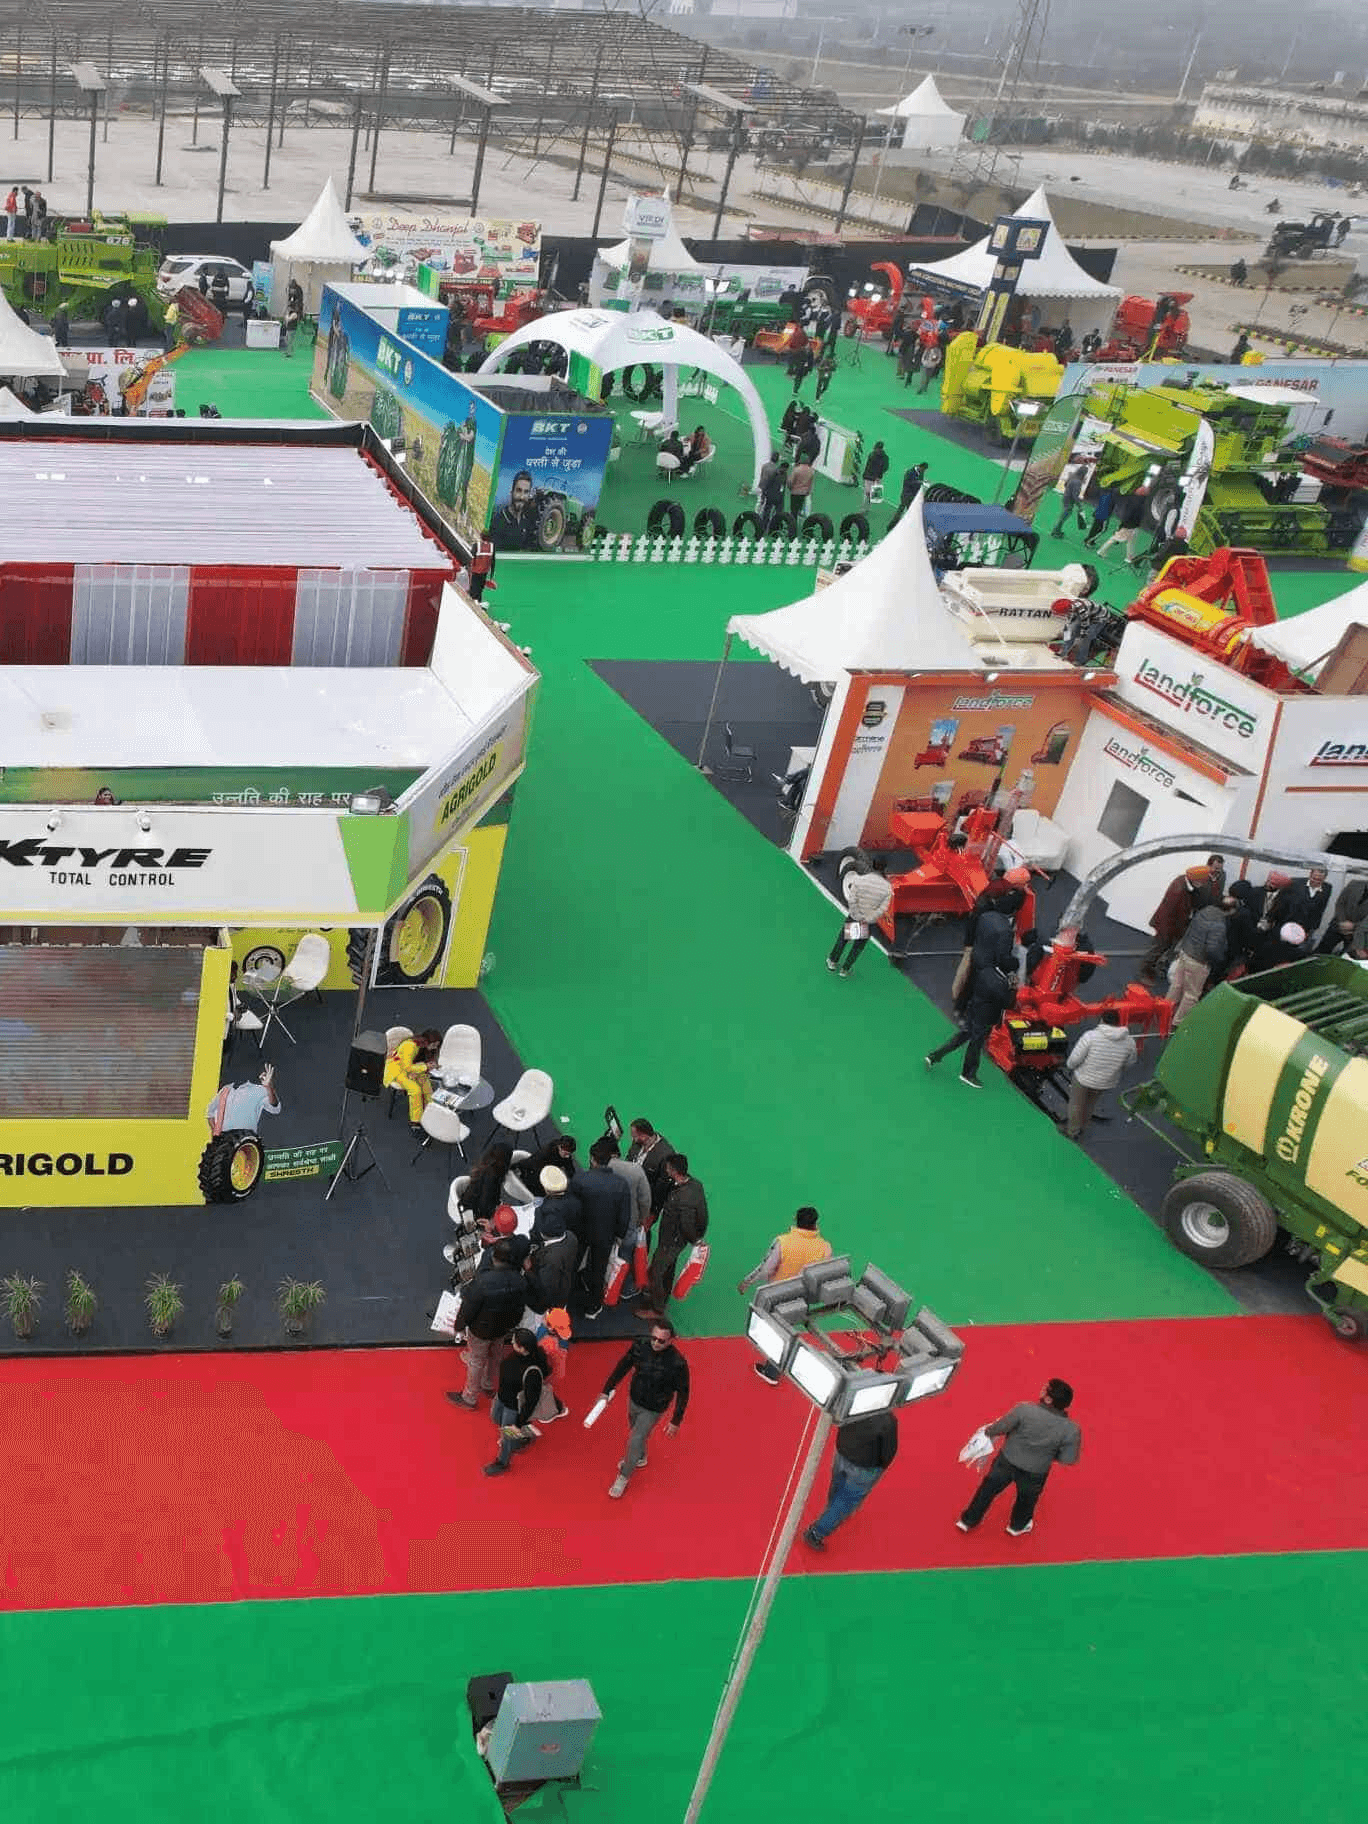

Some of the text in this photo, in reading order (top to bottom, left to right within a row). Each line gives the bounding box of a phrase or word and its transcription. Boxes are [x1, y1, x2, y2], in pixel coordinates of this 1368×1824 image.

[378, 337, 403, 375] BKT
[532, 421, 572, 433] BKT
[999, 607, 1053, 619] RATTAN
[951, 694, 1035, 711] landforce
[1134, 658, 1257, 738] landforce
[1104, 737, 1176, 789] landforce
[212, 786, 353, 806] उन्नति की राह पर
[440, 752, 497, 825] AGRIGOLD
[49, 871, 175, 887] TOTAL CONTROL
[1286, 1054, 1329, 1144] KRONE
